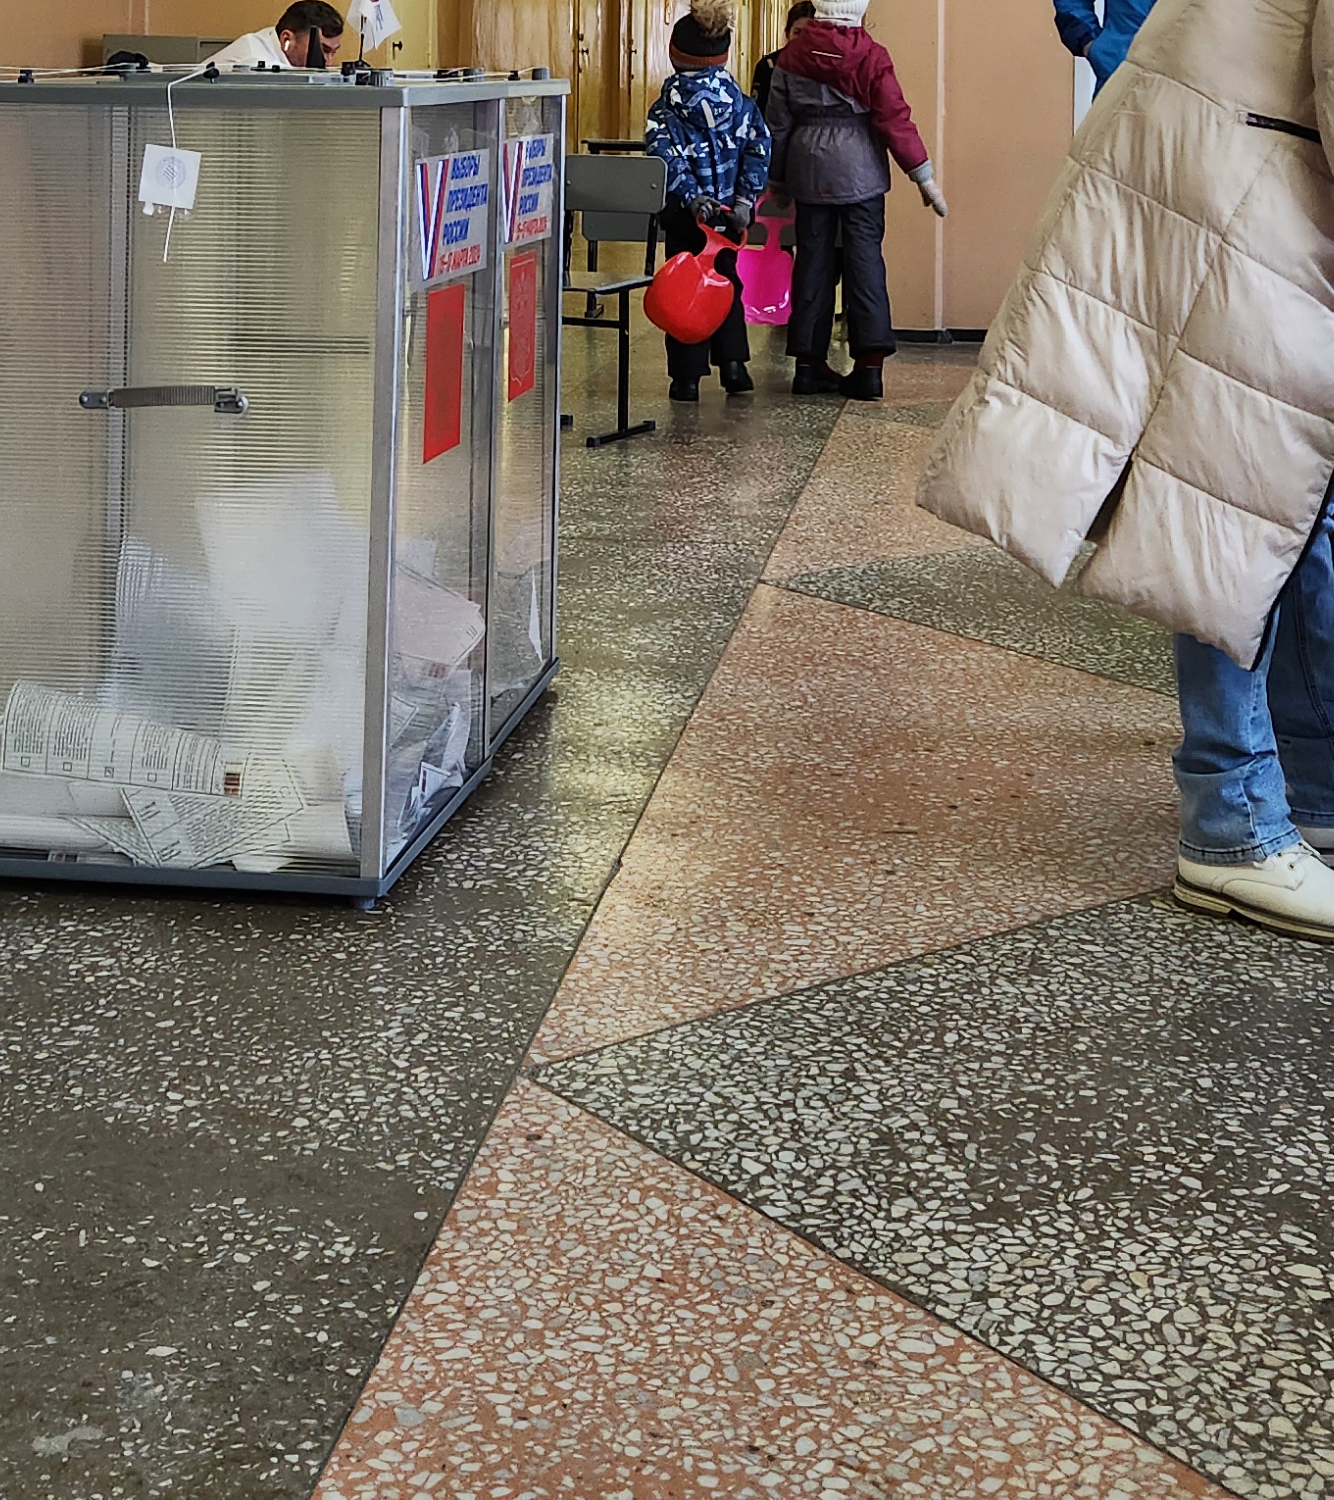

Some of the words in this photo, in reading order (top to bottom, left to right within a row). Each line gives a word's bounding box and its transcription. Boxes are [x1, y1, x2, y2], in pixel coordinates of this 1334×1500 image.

[450, 155, 481, 180] ВЫБОРЫ
[446, 184, 488, 212] ПРЕЗИДЕНТА
[442, 218, 469, 245] РОССИИ
